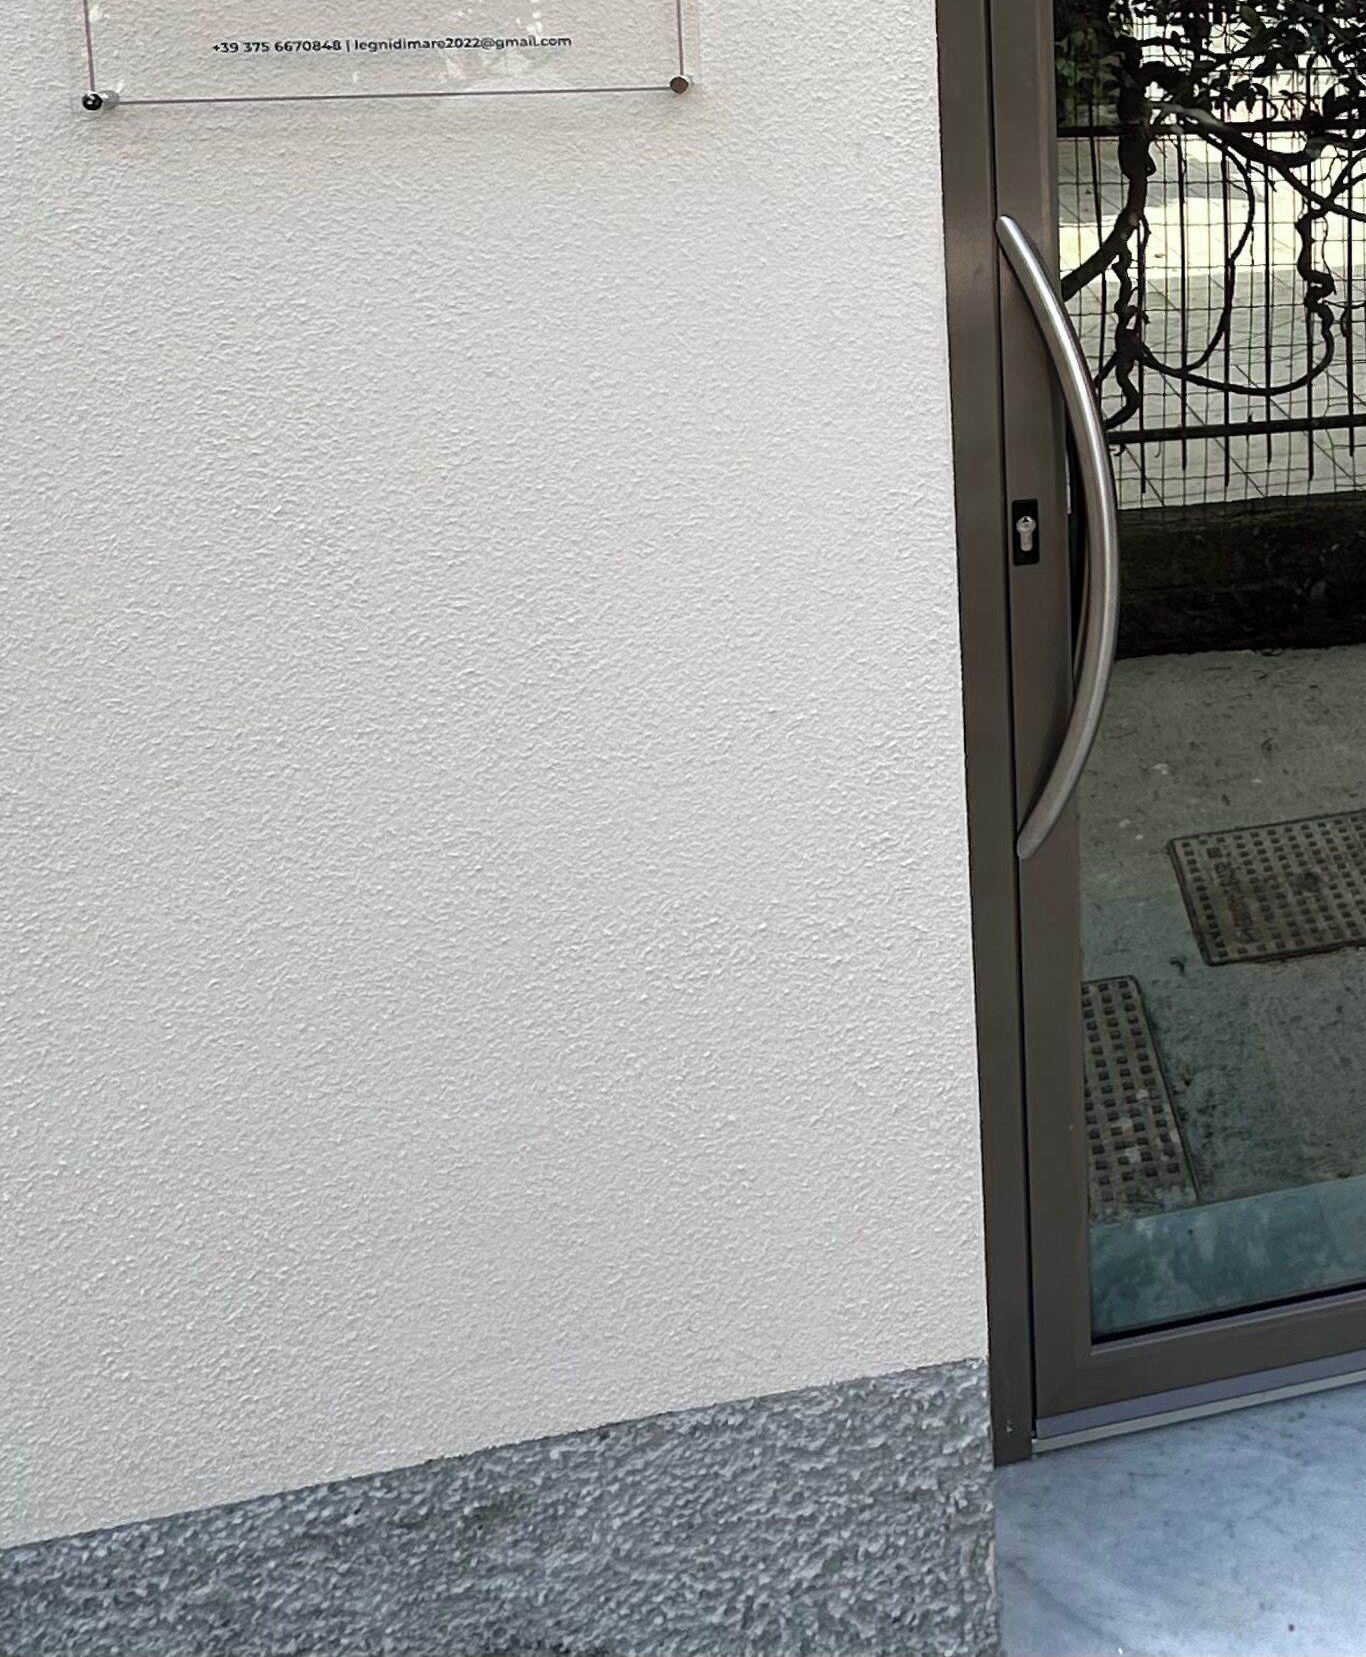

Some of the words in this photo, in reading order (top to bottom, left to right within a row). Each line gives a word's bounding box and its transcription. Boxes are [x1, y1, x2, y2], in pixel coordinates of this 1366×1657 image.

[212, 41, 239, 53] +39
[243, 41, 270, 53] 375
[354, 36, 571, 53] legnidimare2022@gmail.com
